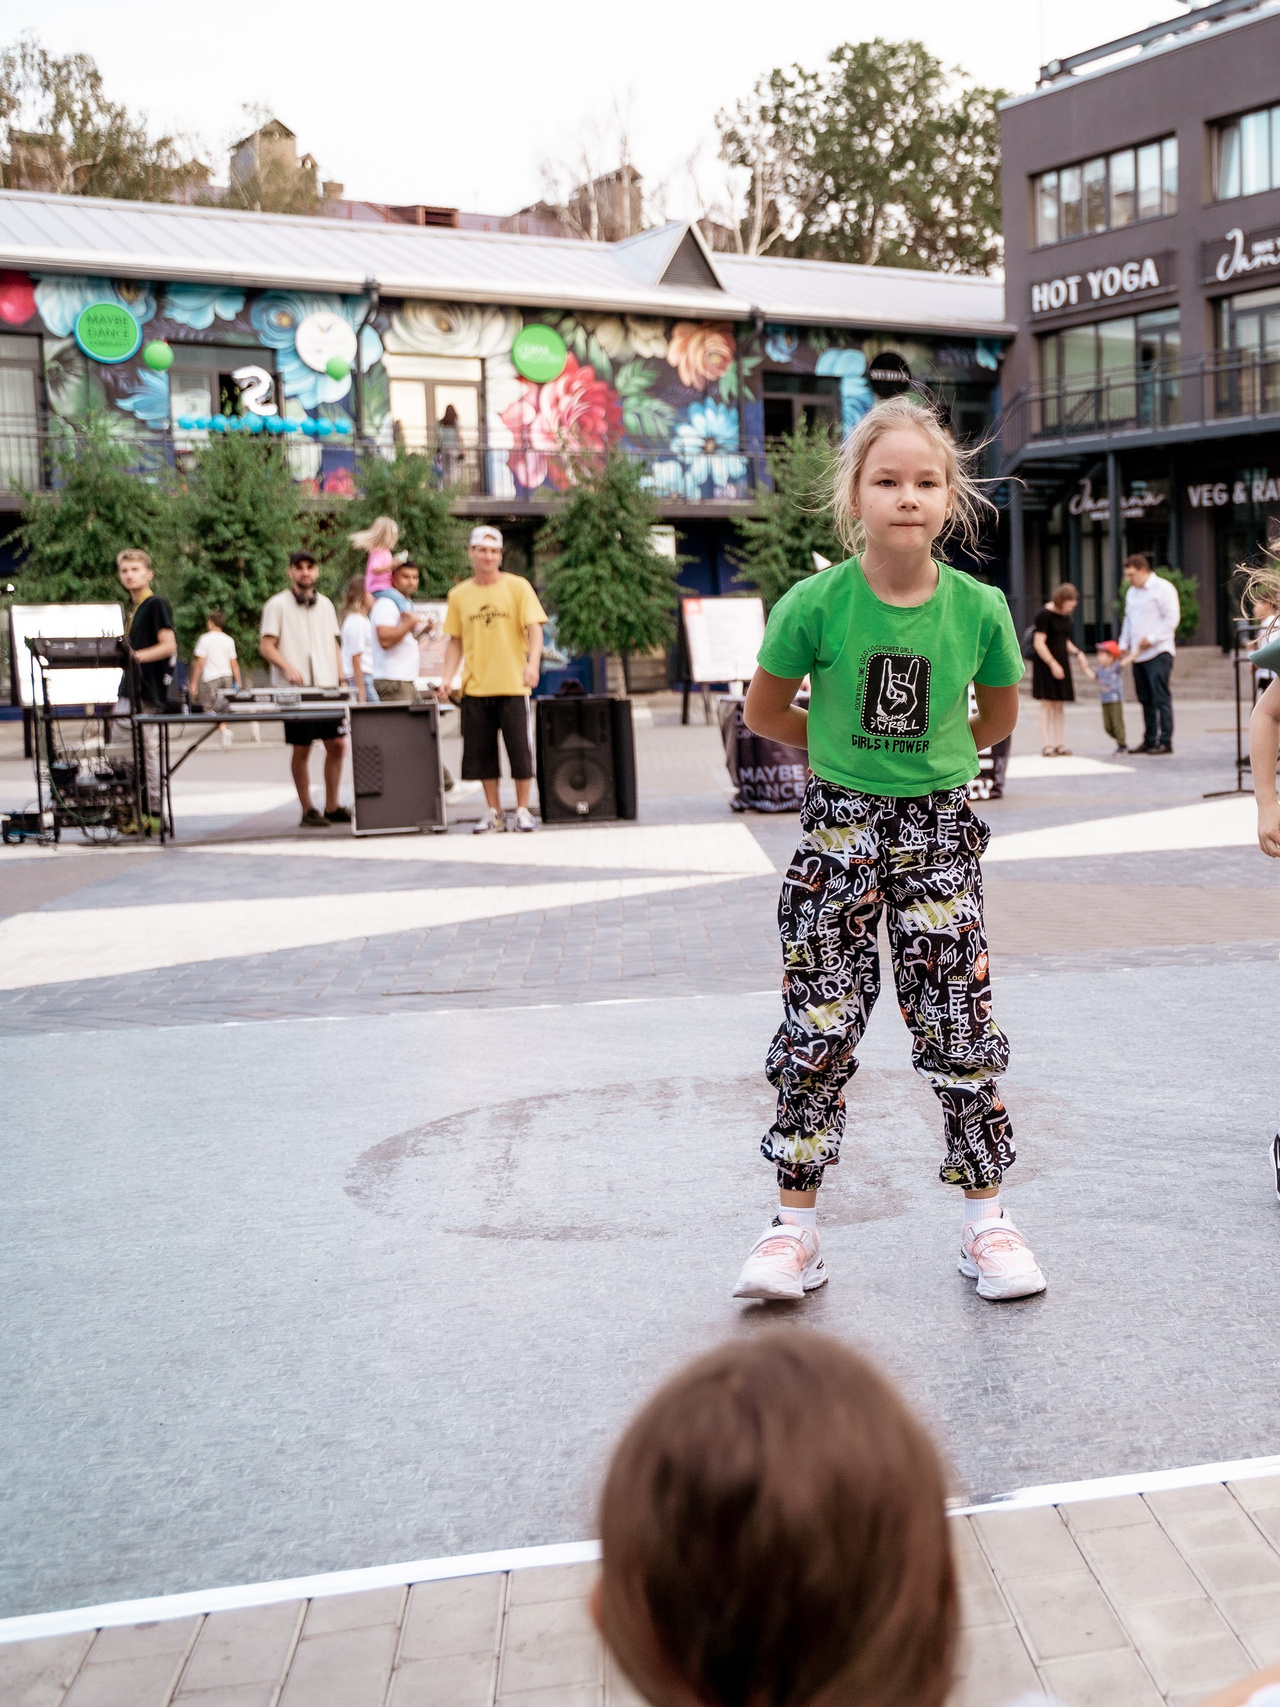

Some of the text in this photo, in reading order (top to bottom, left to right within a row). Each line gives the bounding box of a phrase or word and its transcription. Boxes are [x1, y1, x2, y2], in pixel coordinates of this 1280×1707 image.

[1032, 257, 1160, 313] HOT YOGA
[86, 313, 129, 325] MAYBE
[87, 327, 130, 338] DANCE
[1187, 483, 1229, 508] VEG
[1232, 480, 1248, 505] &
[852, 734, 929, 754] GIRLS POWER
[740, 764, 805, 783] MAYBE
[742, 782, 805, 800] DANCE
[958, 922, 979, 933] LOCO
